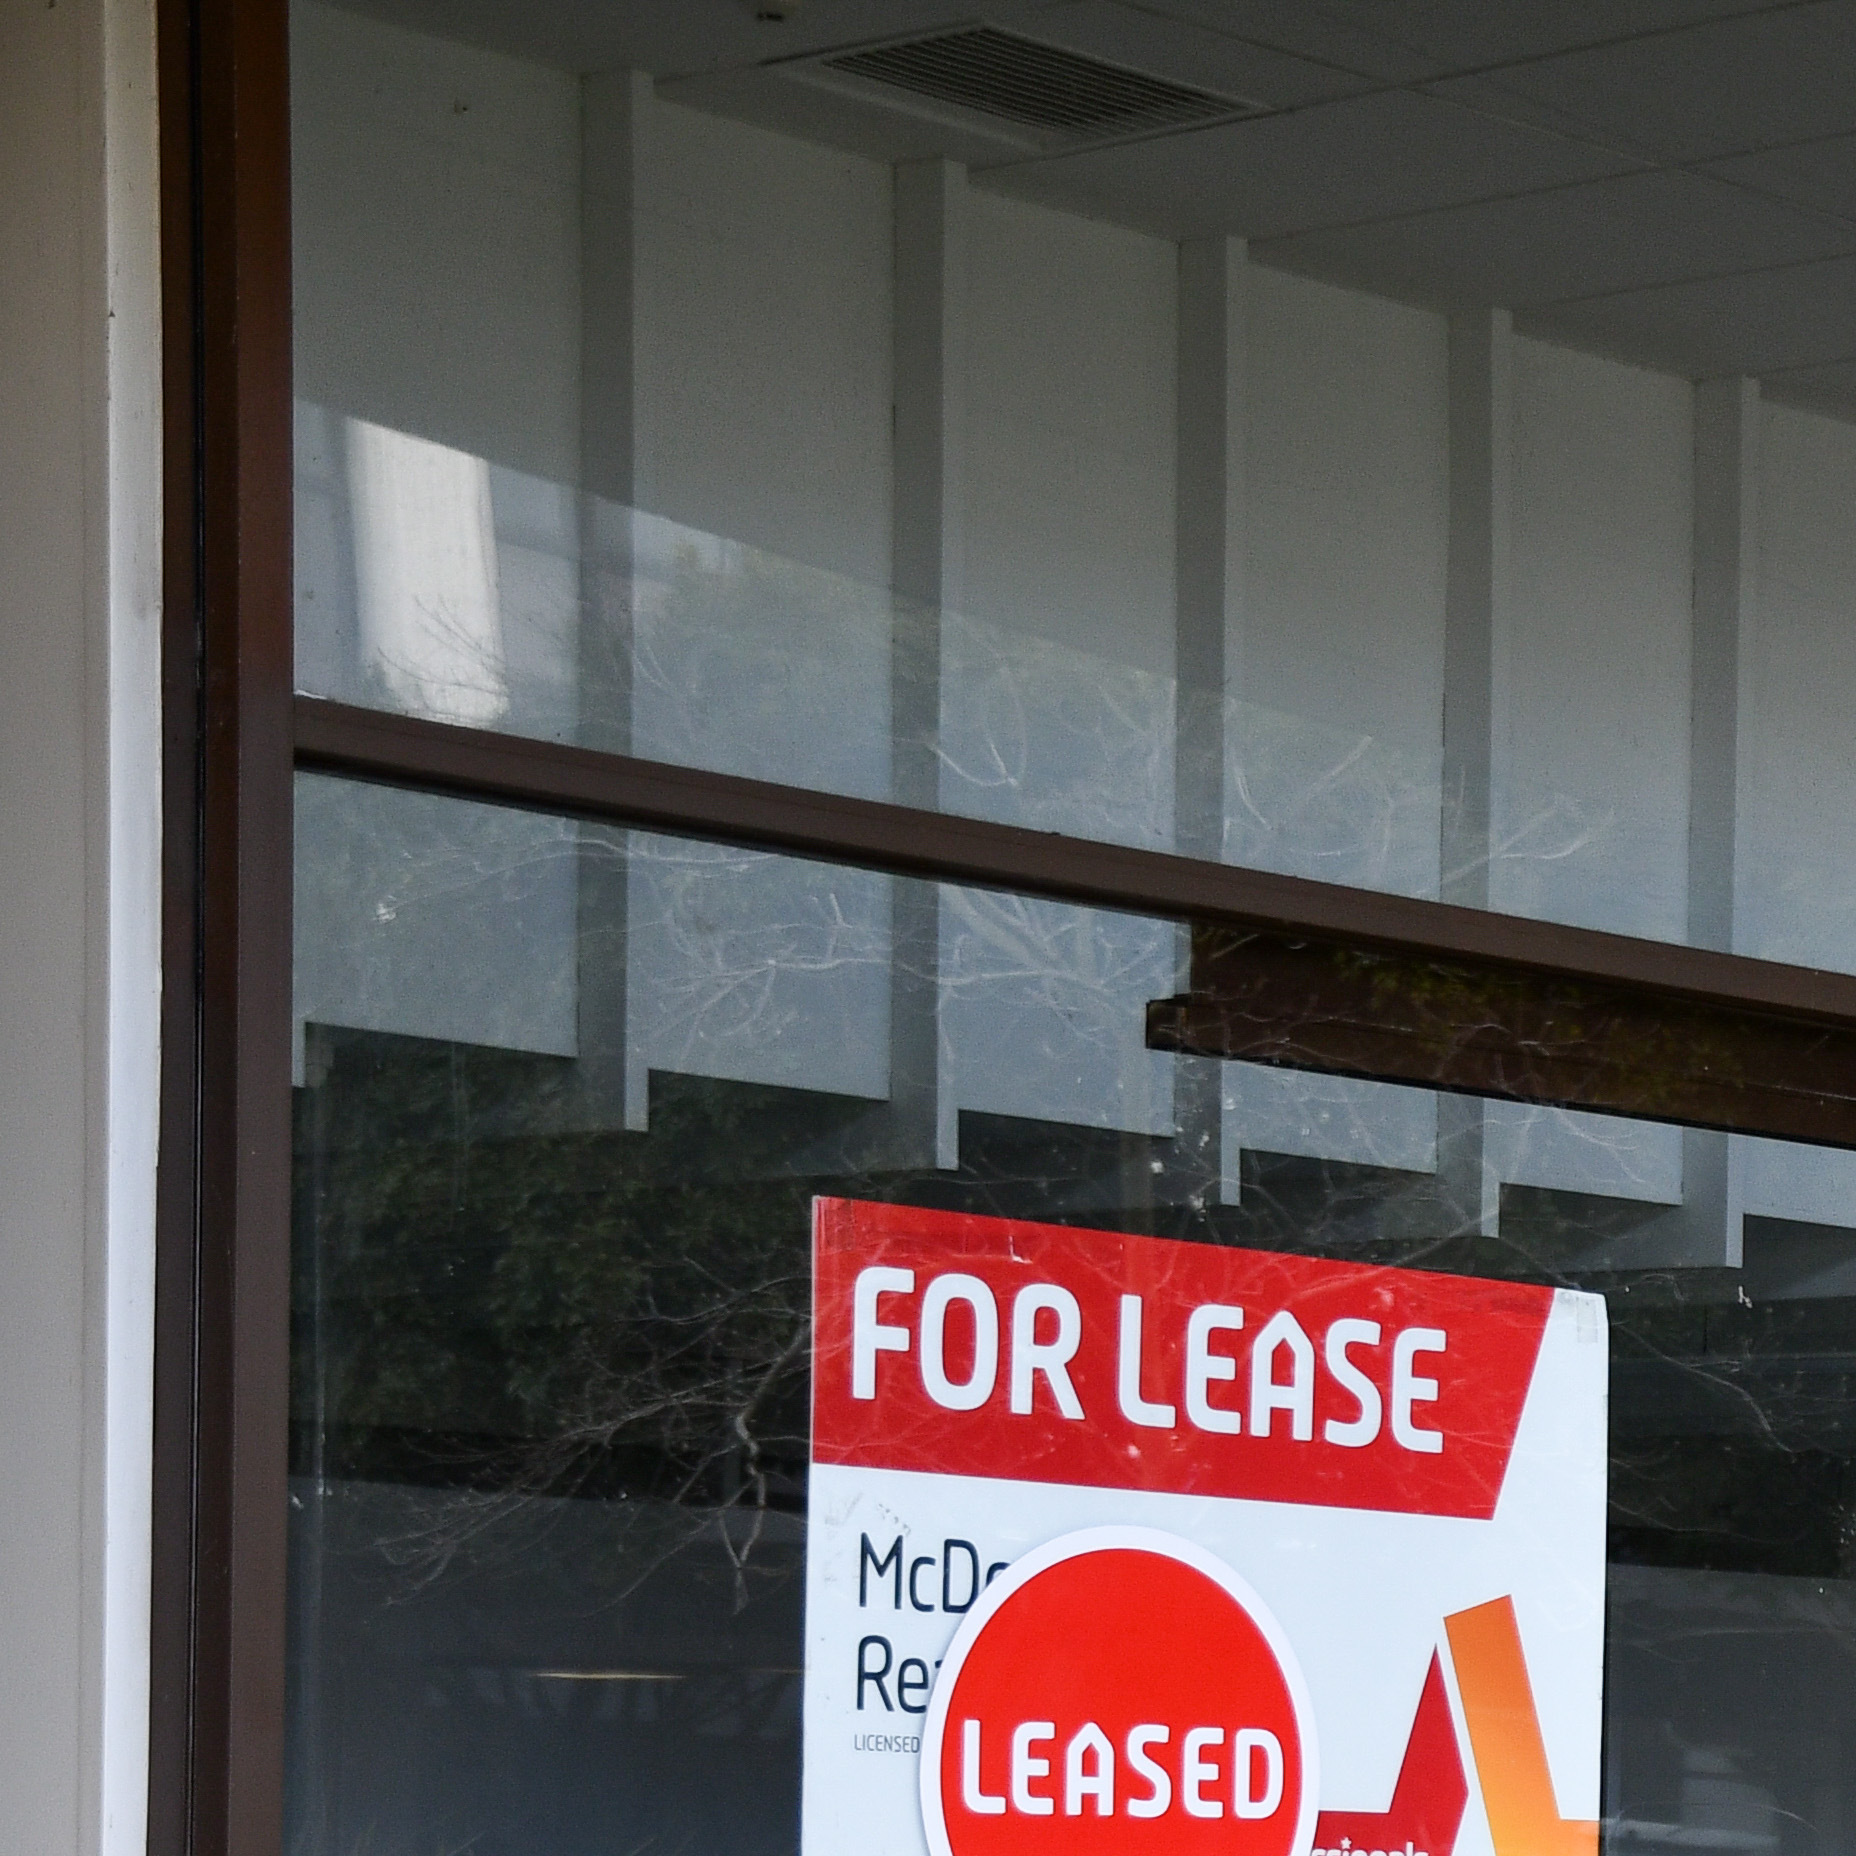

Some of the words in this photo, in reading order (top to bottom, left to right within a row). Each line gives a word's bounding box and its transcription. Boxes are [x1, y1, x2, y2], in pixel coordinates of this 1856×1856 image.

[851, 1266, 1085, 1421] FOR
[1118, 1293, 1447, 1454] LEASE
[856, 1634, 943, 1714] Re
[854, 1734, 920, 1753] LICENSED
[961, 1717, 1285, 1820] LEASED
